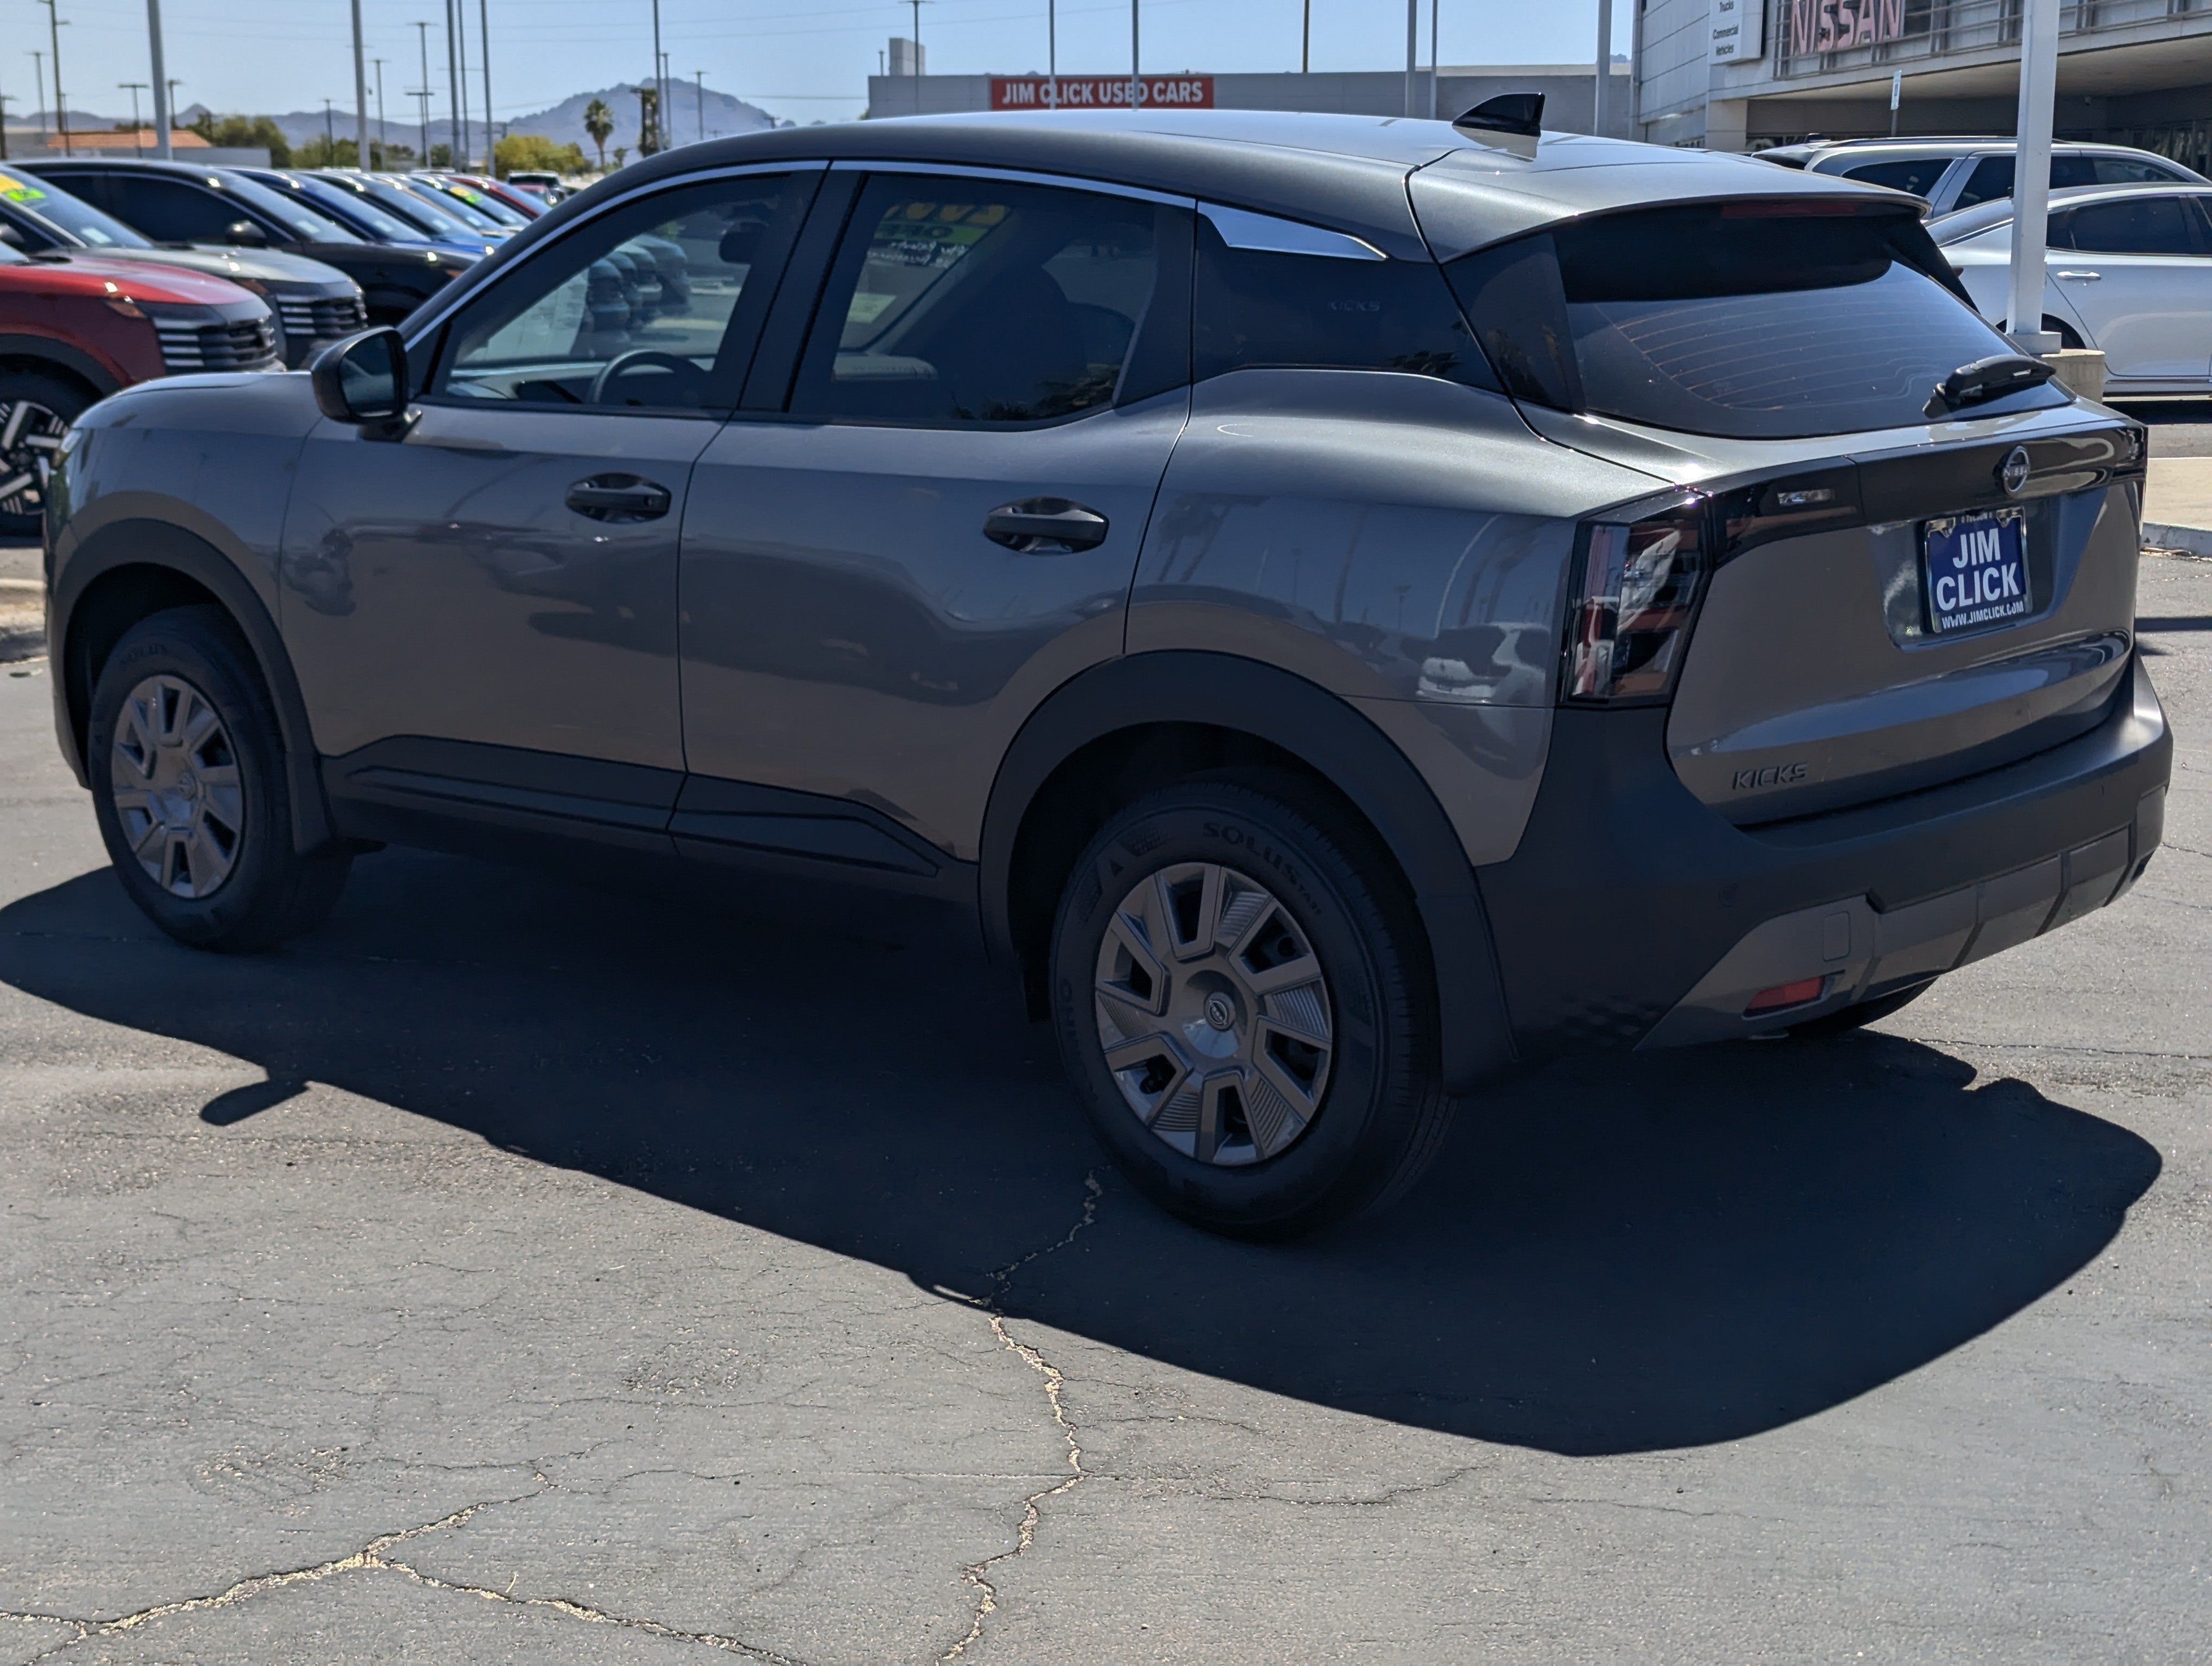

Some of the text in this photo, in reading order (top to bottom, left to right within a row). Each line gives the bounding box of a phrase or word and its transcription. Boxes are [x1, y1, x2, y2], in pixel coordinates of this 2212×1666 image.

[1790, 0, 1900, 55] NISSAN
[1002, 83, 1035, 104] JIM
[1099, 82, 1148, 104] USED
[1153, 81, 1204, 103] CARS
[1952, 528, 2001, 569] JIM
[1936, 562, 2020, 611] CLICK
[1941, 600, 2024, 629] WWW.JIMCLICK.COM
[1732, 761, 1808, 790] KICKS
[1203, 822, 1300, 885] SOLUS
